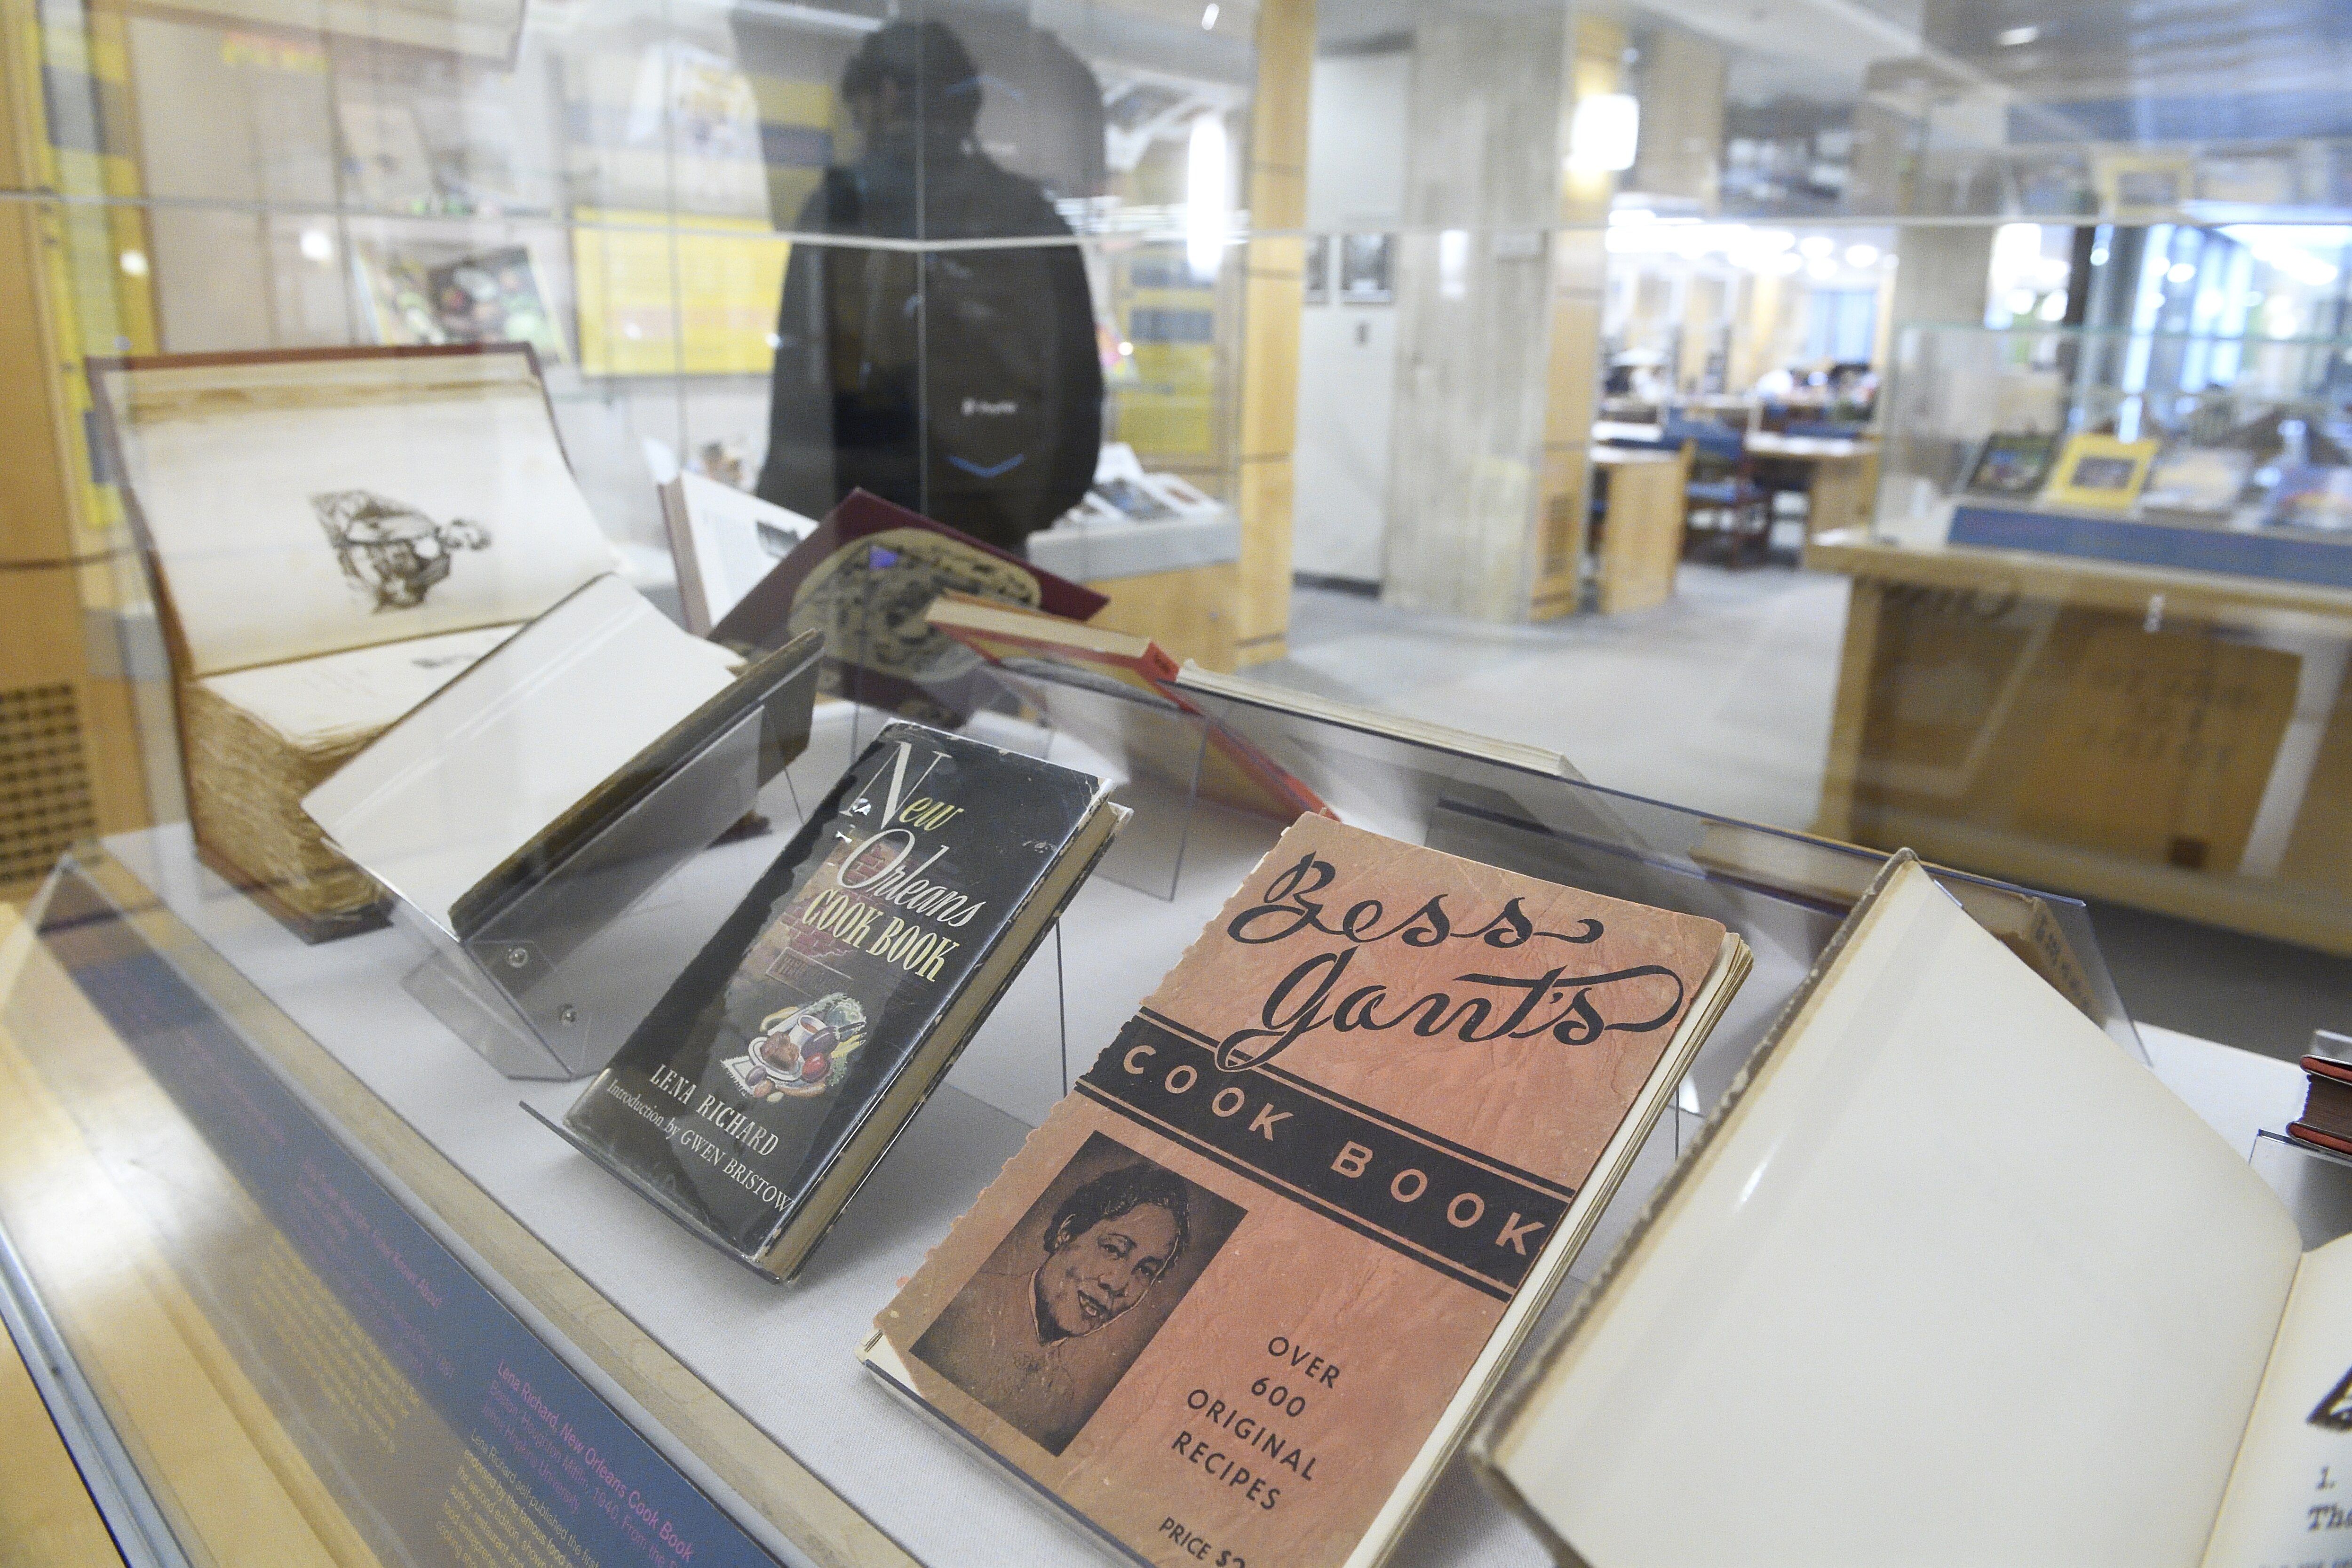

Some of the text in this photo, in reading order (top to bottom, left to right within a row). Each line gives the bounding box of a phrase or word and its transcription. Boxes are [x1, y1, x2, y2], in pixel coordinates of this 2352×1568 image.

[839, 741, 964, 831] New
[837, 828, 986, 927] Orleans
[1227, 851, 1604, 947] Bess
[802, 889, 883, 948] COOK
[866, 916, 960, 982] BOOK
[607, 1080, 794, 1212] Introduction by GWEN BRISTOW
[649, 1064, 779, 1156] LENA RICHARD
[1122, 1043, 1548, 1256] COOK BOOK
[1251, 1377, 1306, 1417] 600
[1268, 1336, 1340, 1389] OVER
[498, 1359, 520, 1392] Lena
[560, 1423, 584, 1454] New
[585, 1447, 627, 1497] Orleans
[628, 1490, 659, 1529] Cook
[659, 1520, 692, 1562] Book
[1171, 1431, 1280, 1510] RECIPES
[1187, 1389, 1316, 1481] ORIGINAL
[464, 1449, 565, 1565] endorsed by the famous food
[469, 1480, 495, 1513] second
[470, 1427, 488, 1453] Lena
[489, 1446, 516, 1483] Richard
[516, 1480, 569, 1539] self-published
[568, 1534, 581, 1555] the
[474, 1512, 509, 1556] restaurant
[622, 1514, 647, 1551] From
[648, 1544, 665, 1567] the
[1159, 1516, 1212, 1560] PRICE
